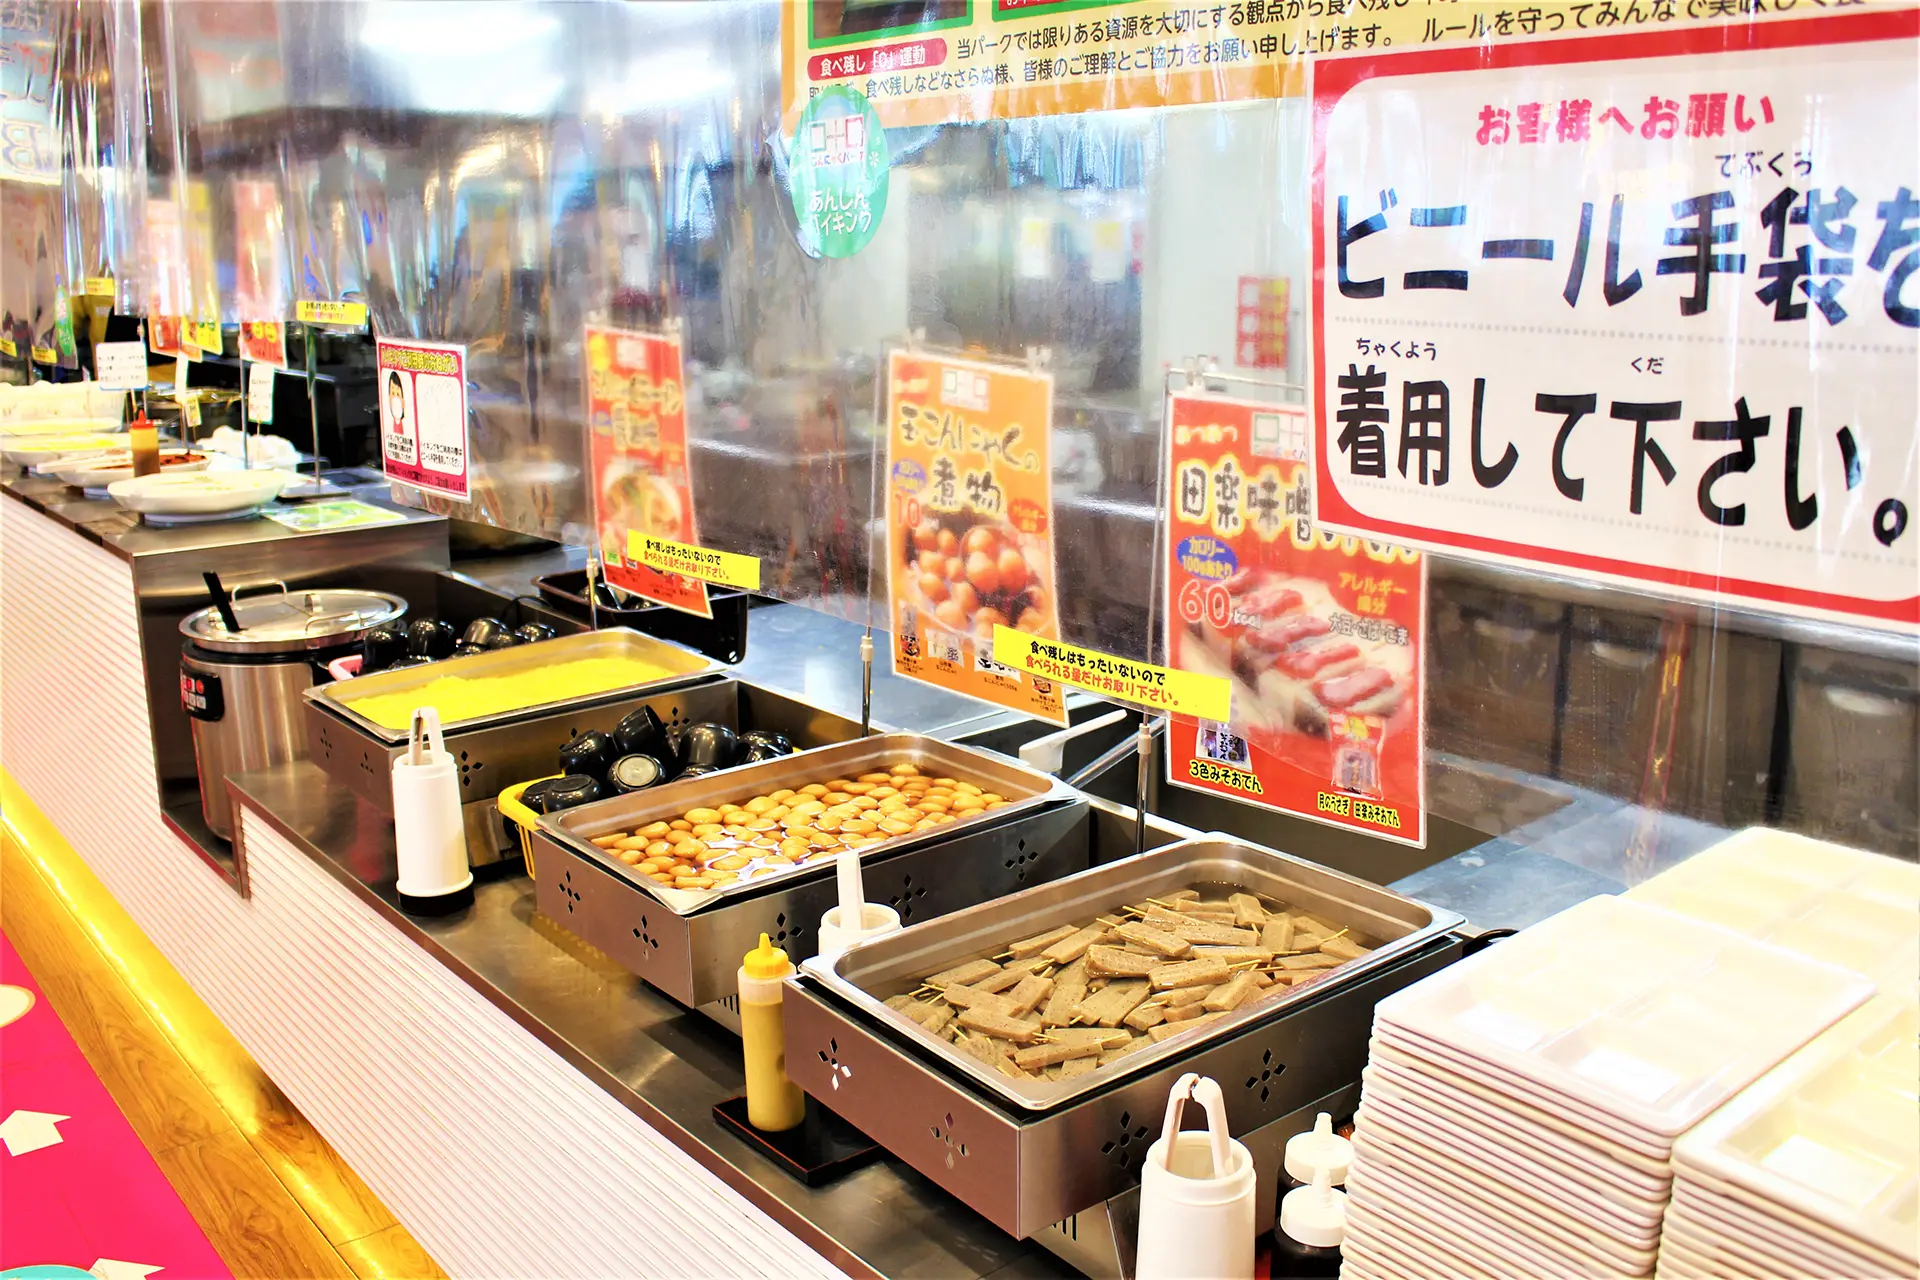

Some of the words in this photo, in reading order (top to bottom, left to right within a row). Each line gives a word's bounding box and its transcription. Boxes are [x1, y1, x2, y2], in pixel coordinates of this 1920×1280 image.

[1475, 92, 1775, 146] お客様へお願い
[1356, 337, 1436, 361] ちゃくよう
[1630, 357, 1664, 375] くだ
[1337, 362, 1908, 546] 着用して下さい。
[933, 457, 1002, 513] 煮物
[645, 539, 721, 566] 食べ残しはもったいないので
[1338, 571, 1407, 596] アレルギー
[1025, 654, 1179, 706] 食べられる量だけお取り下さい。
[1030, 641, 1166, 686] 食べ残しはもったいないので
[1190, 761, 1262, 793] 3色みそおでん
